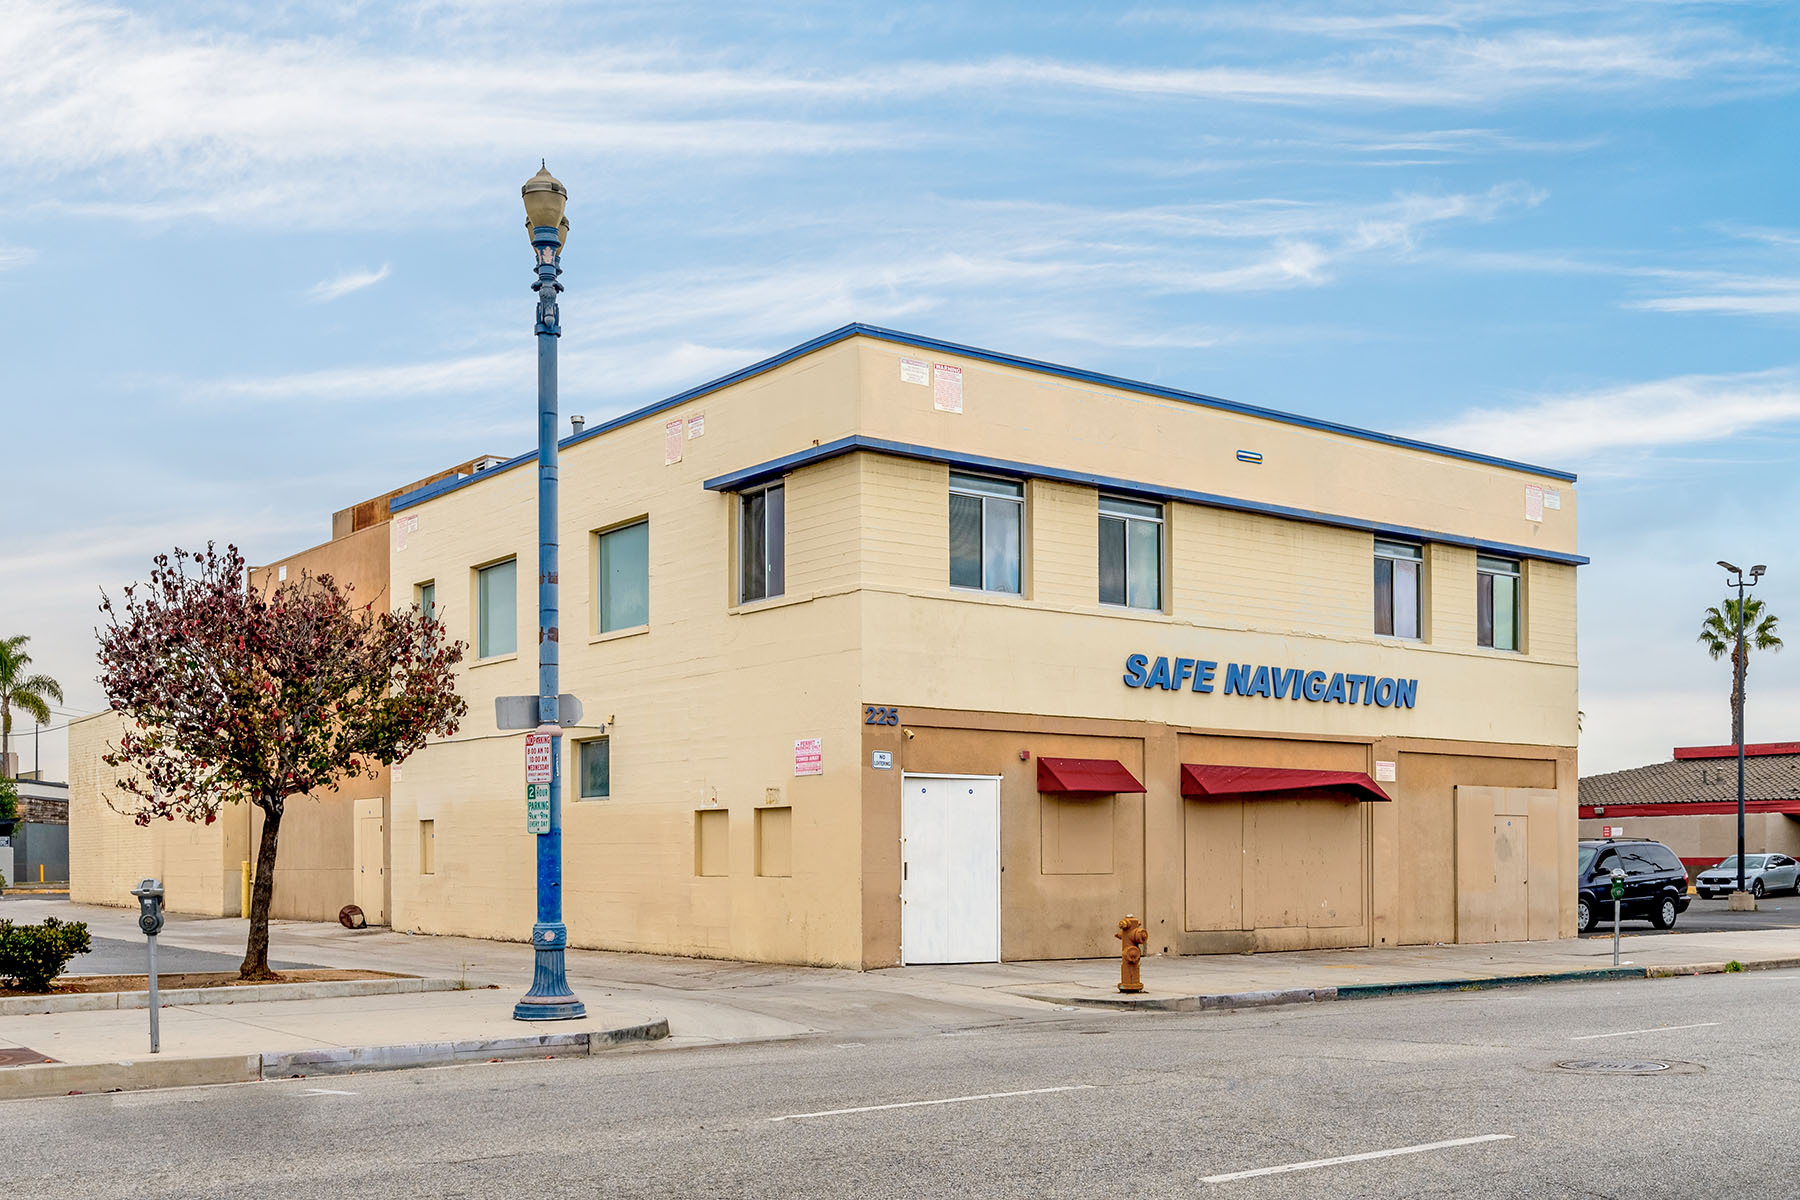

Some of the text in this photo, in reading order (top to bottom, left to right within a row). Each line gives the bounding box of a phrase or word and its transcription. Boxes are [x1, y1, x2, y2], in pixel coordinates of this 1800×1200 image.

[935, 363, 961, 374] WARNING
[1123, 653, 1418, 708] SAFE NAVIGATION
[865, 706, 899, 726] 225
[534, 736, 550, 745] PARKING
[529, 786, 534, 798] 2
[528, 801, 549, 811] PARKING
